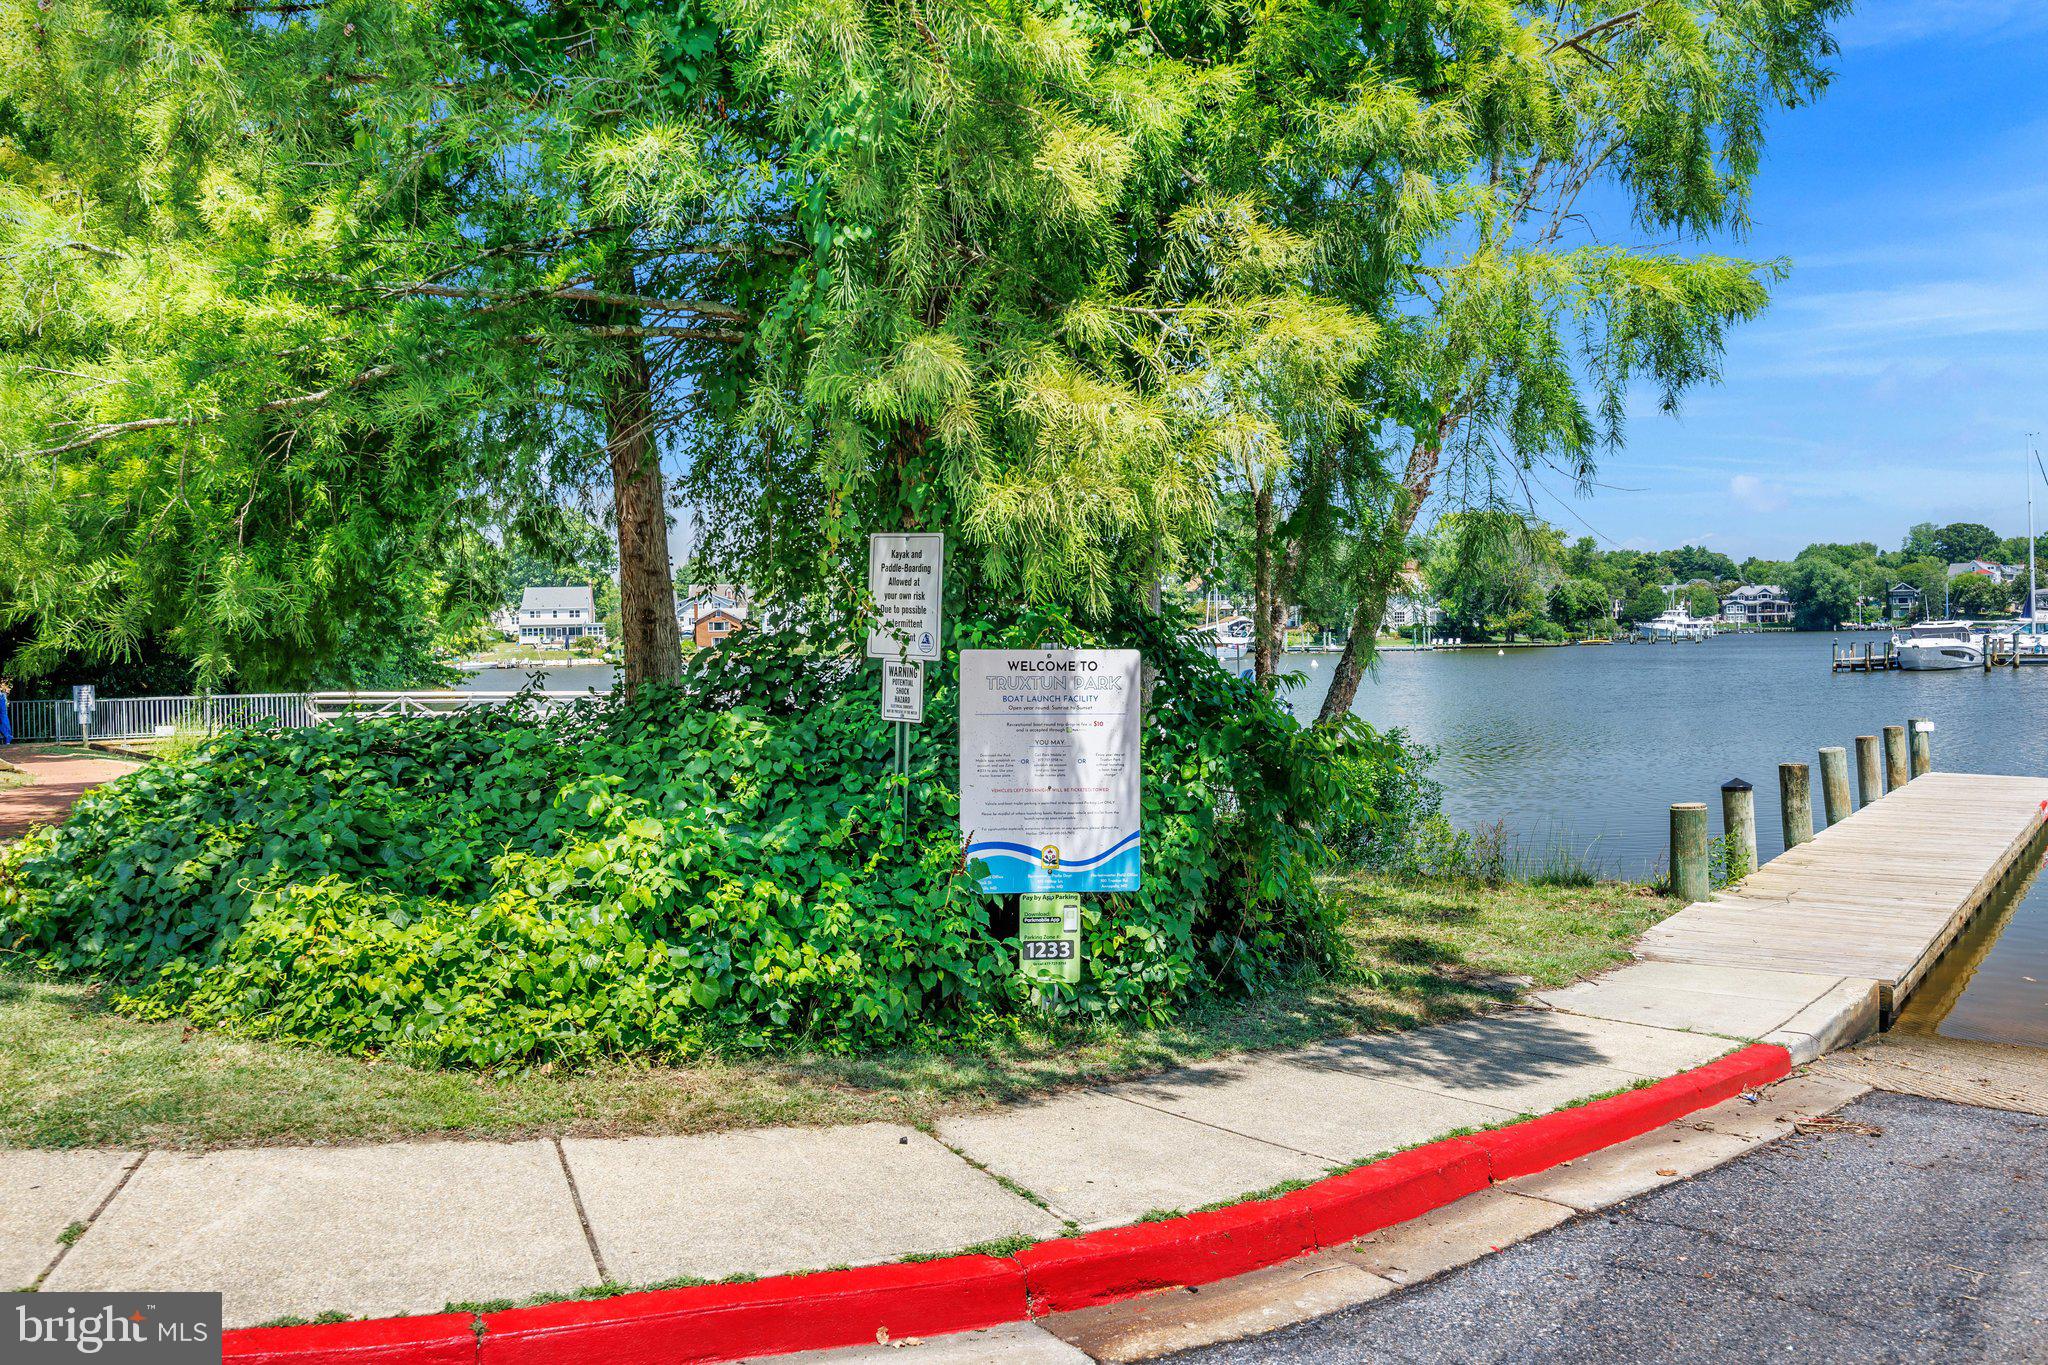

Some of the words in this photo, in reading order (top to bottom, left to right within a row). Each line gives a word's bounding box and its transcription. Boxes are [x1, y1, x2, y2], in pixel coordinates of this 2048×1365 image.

[891, 549, 909, 560] Kayak
[911, 550, 922, 559] and
[881, 563, 931, 574] Paddle-Boarding
[888, 577, 912, 586] Allowed
[913, 577, 920, 586] at
[884, 593, 897, 601] your
[913, 591, 925, 600] risk
[880, 604, 892, 613] Due
[893, 605, 900, 613] to
[901, 605, 927, 615] possible
[888, 666, 918, 678] WARNING
[1007, 661, 1076, 672] WELCOME
[1082, 661, 1098, 671] TO
[892, 678, 913, 687] POTENTIAL
[986, 676, 1067, 691] TRUXTUN
[1073, 676, 1122, 690] PARK
[896, 687, 909, 695] SHOCK
[895, 696, 910, 704] HAZARD
[1022, 894, 1034, 902] Pay
[1033, 894, 1042, 902] by
[1026, 942, 1071, 959] 1233
